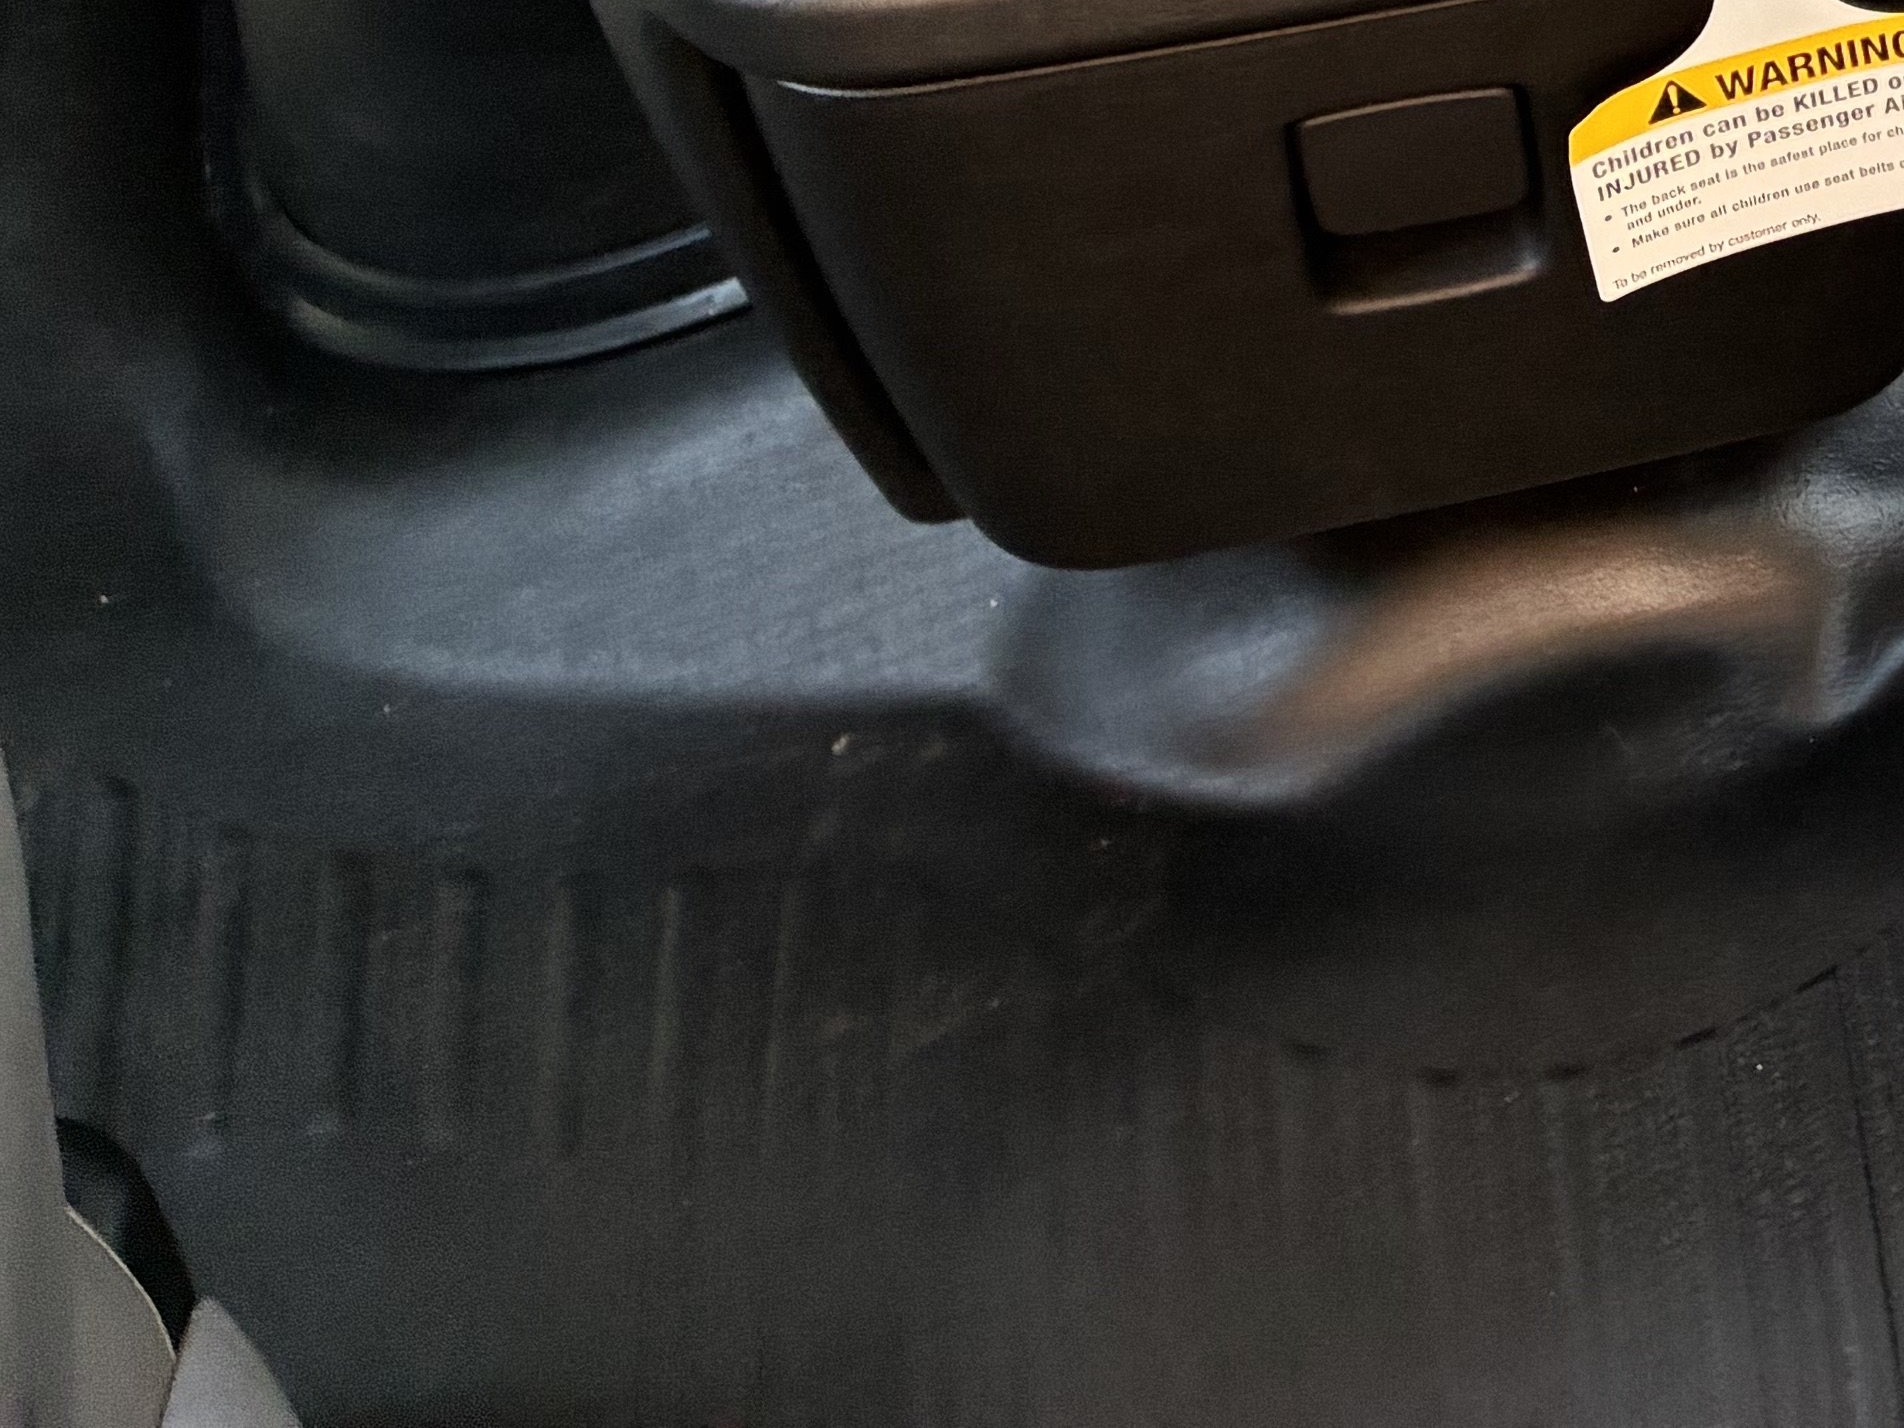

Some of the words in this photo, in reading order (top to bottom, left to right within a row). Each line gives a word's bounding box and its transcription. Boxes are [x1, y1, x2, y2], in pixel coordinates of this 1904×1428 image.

[1592, 129, 1694, 179] Children
[1703, 114, 1747, 138] can
[1755, 104, 1785, 123] be
[1793, 78, 1878, 113] KILLED
[1597, 149, 1700, 202] INJURED
[1710, 139, 1738, 159] by
[1747, 103, 1875, 149] Passenger
[1621, 199, 1647, 218] The
[1651, 186, 1686, 206] back
[1690, 172, 1721, 191] seat
[1725, 168, 1739, 181] is
[1742, 160, 1766, 175] the
[1770, 148, 1815, 167] safest
[1819, 137, 1858, 157] place
[1861, 129, 1883, 143] for
[1627, 213, 1653, 231] and
[1657, 196, 1703, 220] under.
[1631, 226, 1670, 248] Make
[1674, 214, 1706, 232] sure
[1710, 202, 1728, 220] all
[1731, 188, 1790, 212] children
[1794, 181, 1821, 195] use
[1824, 170, 1856, 187] seat
[1858, 161, 1895, 178] belts
[1612, 276, 1628, 291] To
[1631, 270, 1648, 284] be
[1650, 246, 1706, 275] removed
[1709, 241, 1726, 255] by
[1728, 222, 1788, 247] customer
[1791, 213, 1823, 229] only.
